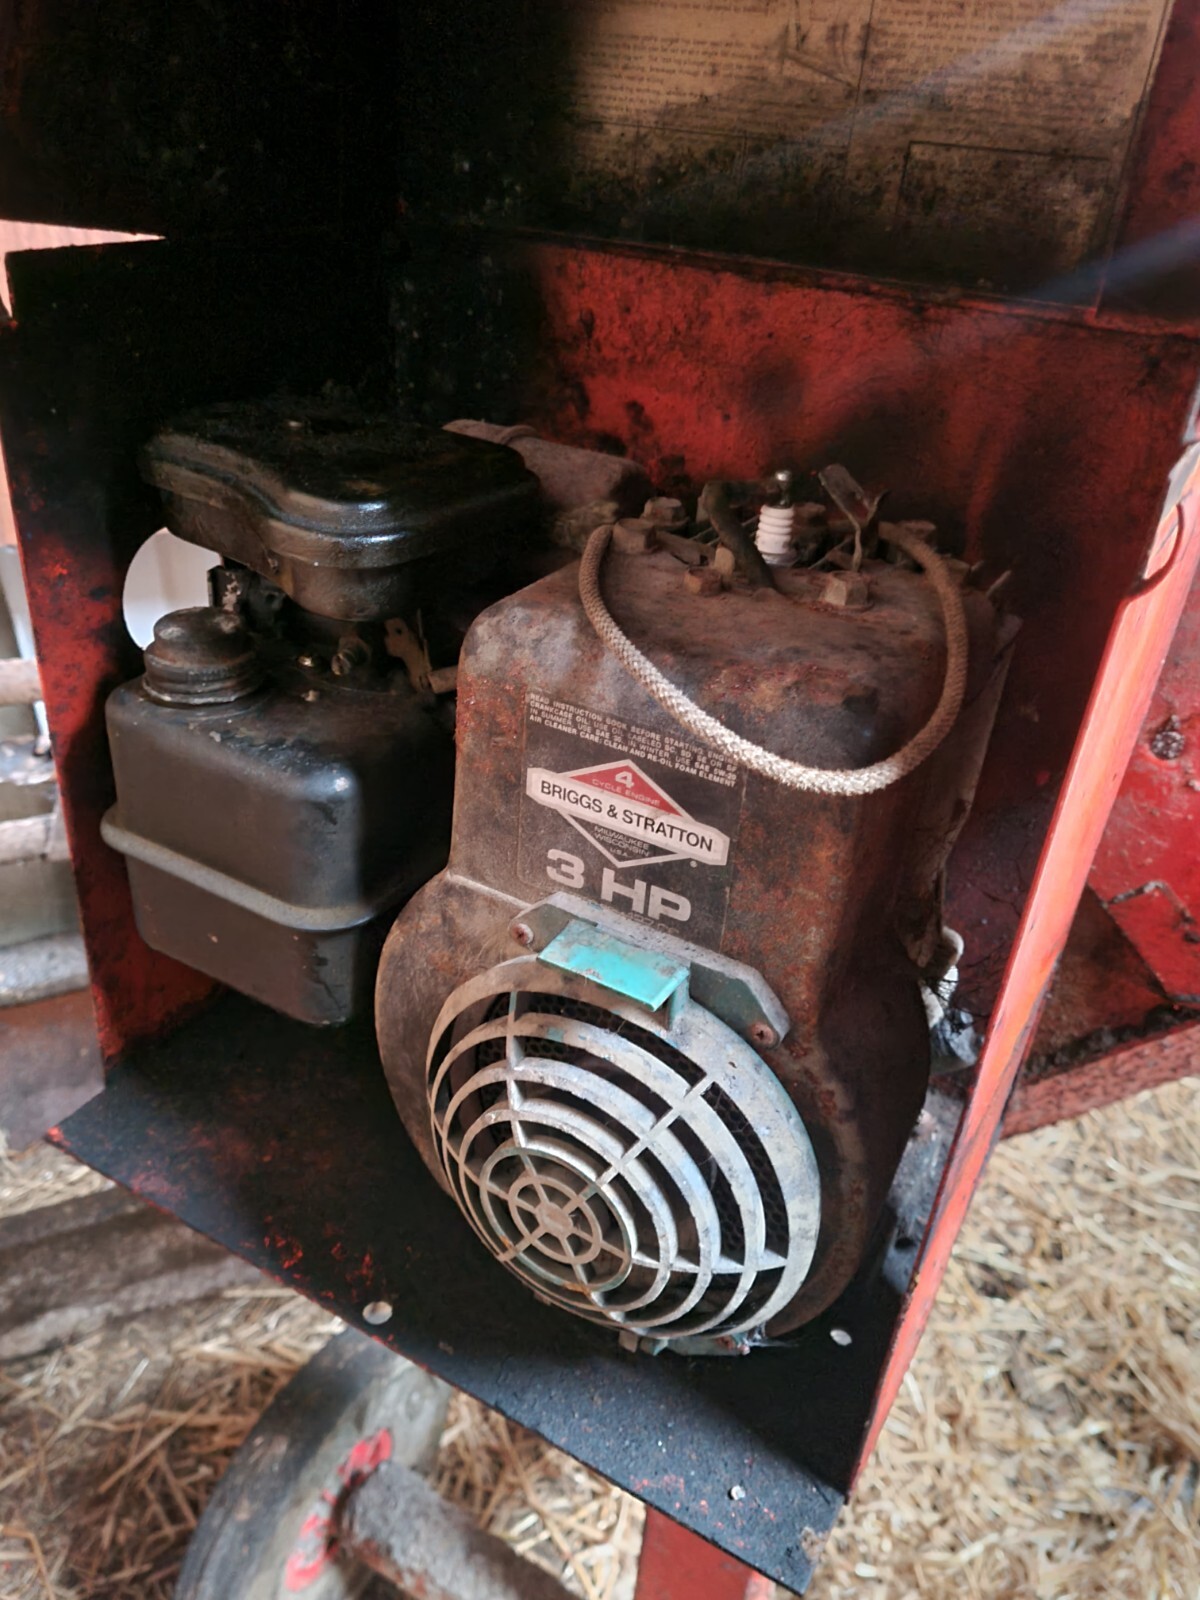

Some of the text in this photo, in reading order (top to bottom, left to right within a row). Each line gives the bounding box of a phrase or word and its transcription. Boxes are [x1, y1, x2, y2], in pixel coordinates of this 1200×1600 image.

[530, 701, 573, 720] CRANKCASE
[594, 721, 608, 731] USE
[628, 734, 662, 748] LABELED
[530, 708, 538, 716] IN
[577, 723, 591, 733] USE
[595, 729, 610, 739] SAE
[675, 756, 691, 767] USE
[695, 762, 710, 772] SAE
[553, 701, 603, 722] INSTRUCTION
[606, 716, 627, 729] BOOK
[630, 726, 661, 741] BEFORE
[664, 737, 704, 755] STARTING
[529, 714, 542, 724] AIR
[544, 719, 578, 735] CLEANER
[603, 739, 628, 753] CLEAN
[629, 748, 646, 758] AND
[647, 754, 673, 768] RE-OIL
[674, 762, 697, 775] FOAM
[699, 770, 736, 788] ELEMENT
[592, 778, 660, 807] CYCLE ENGINE
[615, 771, 635, 788] 4
[541, 780, 713, 852] BRIGGS & STRATTON
[594, 825, 650, 850] MILWAUKEE
[594, 832, 650, 857] WISCONSIN
[546, 848, 585, 889] 3
[600, 867, 691, 922] HP
